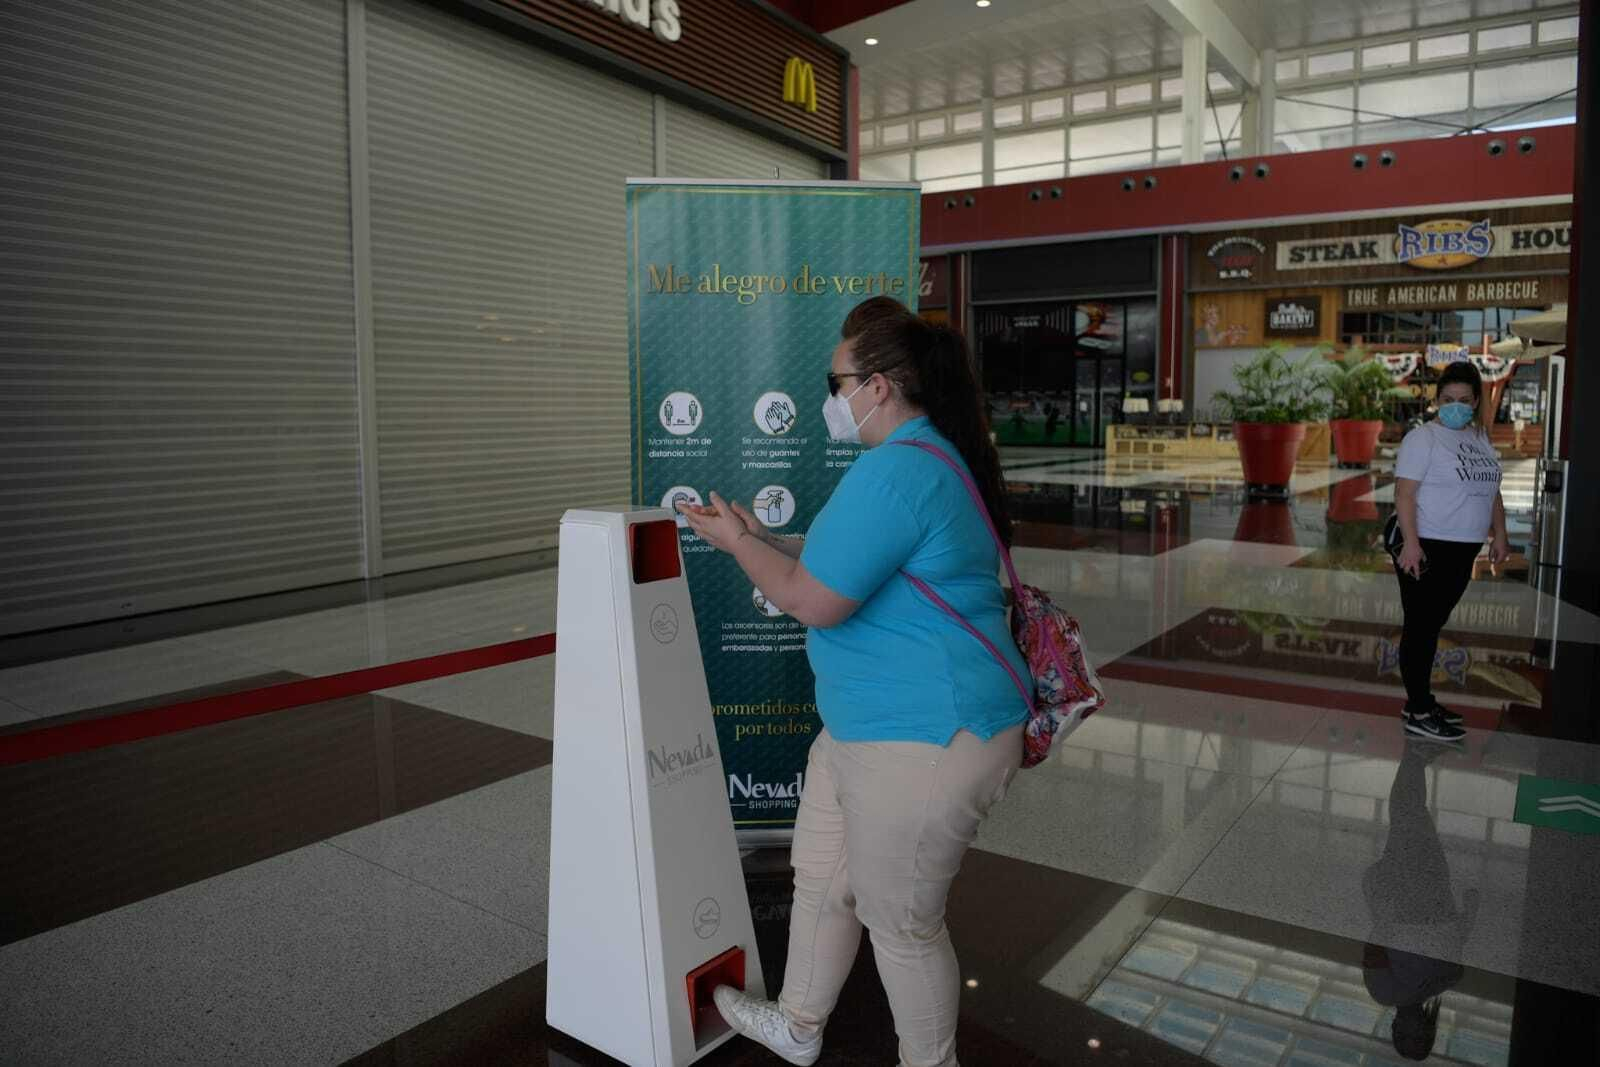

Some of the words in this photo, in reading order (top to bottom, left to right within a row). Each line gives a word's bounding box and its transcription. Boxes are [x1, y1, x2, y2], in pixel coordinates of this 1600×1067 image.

[1289, 241, 1378, 263] STEAK
[1398, 219, 1490, 262] RIBS
[1511, 228, 1572, 250] HOU
[648, 263, 692, 294] Me
[698, 264, 787, 305] alegro
[792, 264, 826, 294] de
[831, 271, 905, 295] verte
[1347, 287, 1379, 307] TRUE
[1387, 285, 1457, 305] AMERICAN
[1467, 280, 1539, 301] BARBECUE
[701, 437, 712, 446] de
[648, 449, 685, 458] distancia
[686, 449, 708, 457] social
[769, 449, 800, 459] guantes
[749, 461, 792, 469] mascarillas
[735, 723, 764, 742] por
[767, 719, 812, 737] todos
[728, 772, 803, 800] Nevad
[748, 799, 798, 809] SHOPPING
